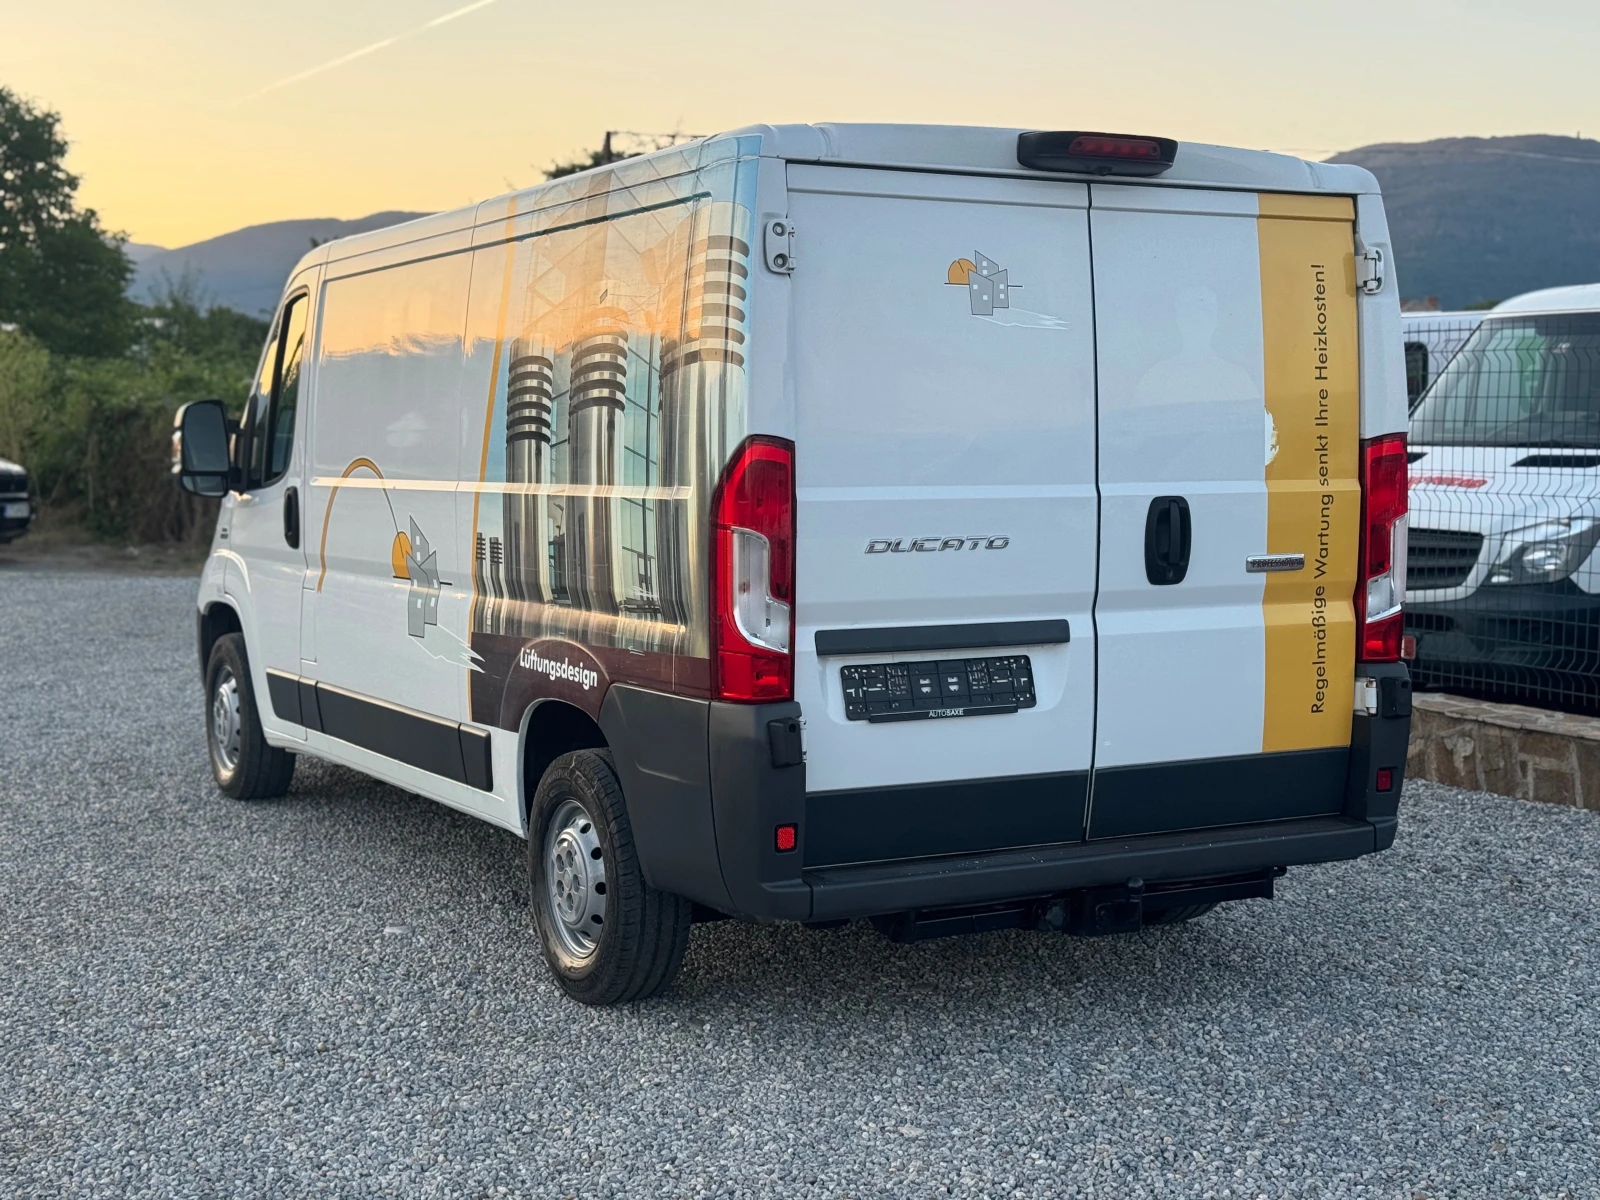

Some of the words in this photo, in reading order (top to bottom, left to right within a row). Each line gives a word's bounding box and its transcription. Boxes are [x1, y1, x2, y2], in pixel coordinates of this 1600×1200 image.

[1310, 263, 1329, 381] Heizkosten!
[1314, 388, 1329, 427] Ihre
[1314, 434, 1329, 487] senkt
[864, 534, 1010, 554] DUCATO
[1314, 494, 1334, 579] Wartung
[1252, 556, 1304, 568] PROFESSIONAL
[519, 647, 598, 690] Lüftungsdesign
[1311, 585, 1329, 714] Regelmäßige
[928, 707, 964, 718] AUTOSAXE
